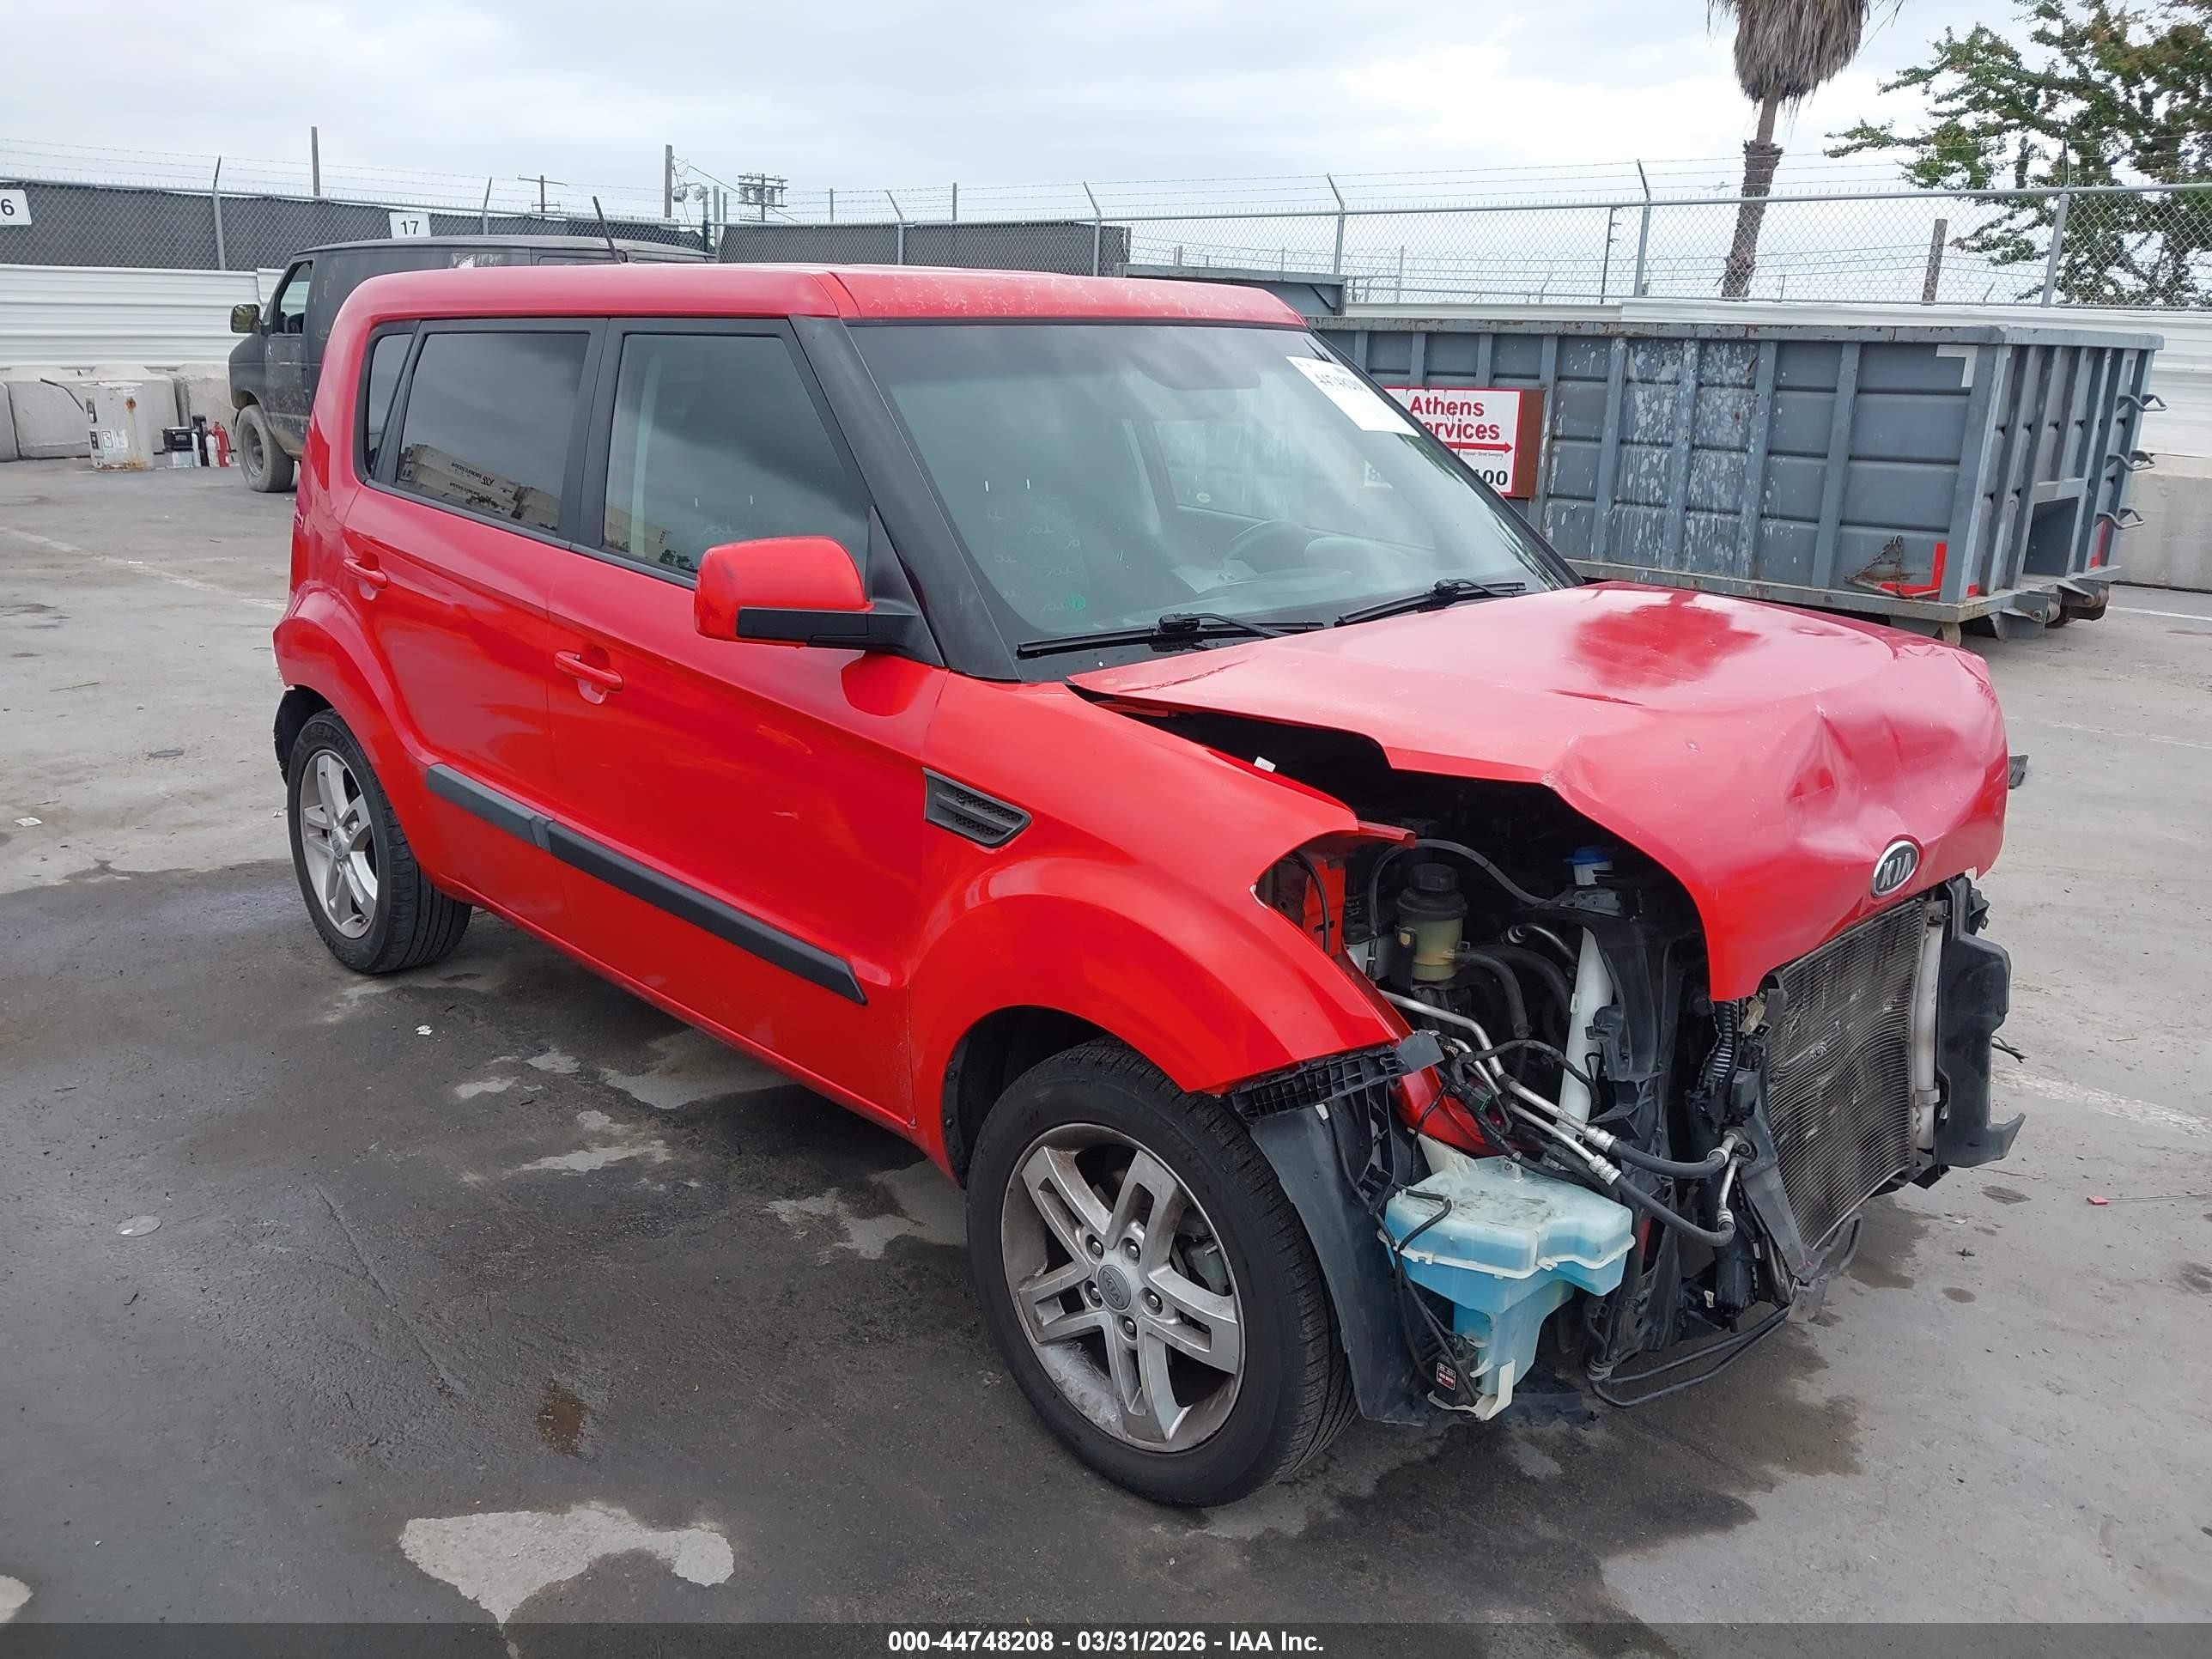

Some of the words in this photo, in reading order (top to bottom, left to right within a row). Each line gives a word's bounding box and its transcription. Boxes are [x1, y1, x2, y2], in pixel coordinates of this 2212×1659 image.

[1, 198, 15, 216] 6
[400, 220, 419, 234] 17
[1410, 396, 1485, 416] Athens
[1424, 419, 1500, 440] ervices
[1476, 469, 1508, 485] 00
[1879, 853, 1911, 889] KIA
